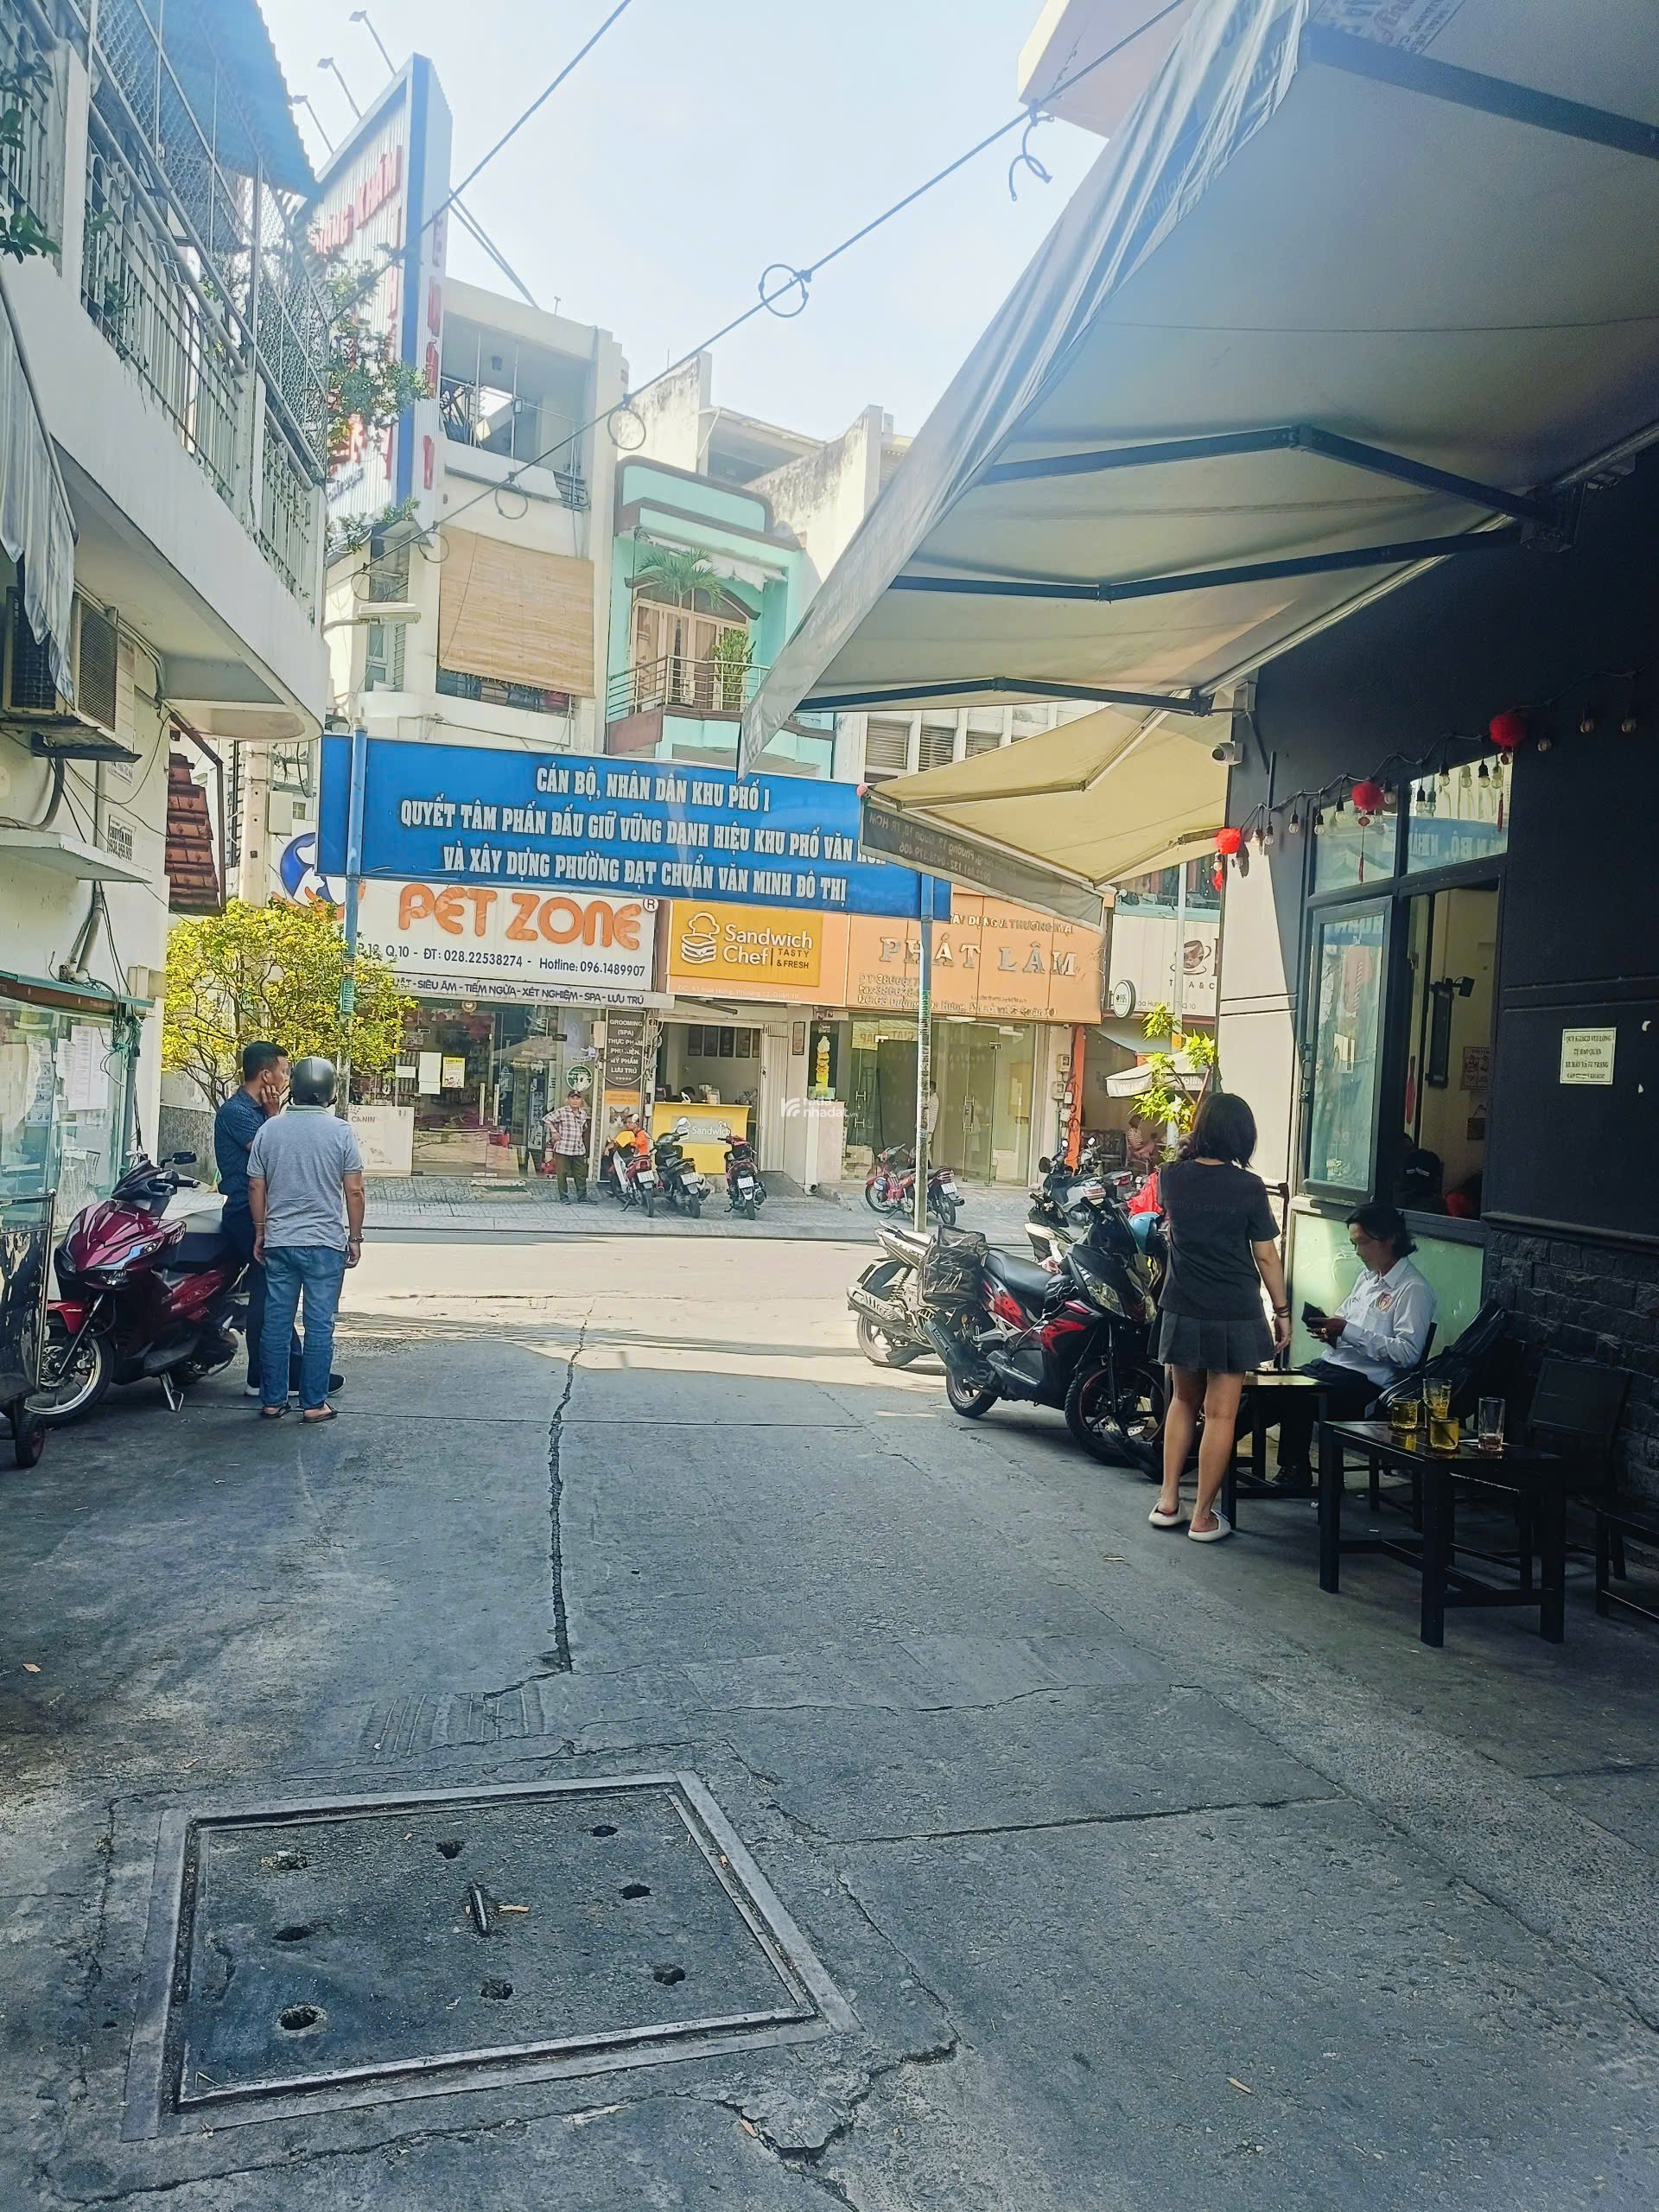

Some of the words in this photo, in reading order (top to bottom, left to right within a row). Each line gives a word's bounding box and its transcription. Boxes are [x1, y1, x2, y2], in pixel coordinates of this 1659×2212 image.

[537, 762, 569, 793] CÁN
[575, 766, 601, 801] BỘ,
[607, 769, 651, 800] NHÂN
[656, 773, 687, 804] DÂN
[692, 781, 724, 807] KHU
[728, 779, 760, 811] PHỐ
[401, 793, 455, 829] QUYẾT
[461, 799, 497, 830] TÂM
[502, 799, 546, 835] PHẤN
[550, 803, 583, 838] ĐẤU
[588, 810, 617, 841] GIỮ
[620, 811, 662, 844] VỮNG
[667, 824, 709, 848] DANH
[713, 821, 750, 856] HIỆU
[754, 830, 785, 855] KHU
[789, 826, 820, 859] PHỐ
[824, 832, 854, 861] VĂN
[443, 839, 465, 872] VÀ
[469, 842, 502, 874] XÂY
[506, 846, 550, 882] DỰNG
[555, 849, 620, 884] PHƯỜNG
[625, 860, 657, 892] ĐẠT
[661, 854, 713, 890] CHUẨN
[718, 864, 748, 893] VĂN
[753, 872, 791, 897] MINH
[796, 869, 817, 899] ĐÔ
[821, 877, 847, 908] THỊ
[398, 883, 498, 938] PET
[724, 924, 813, 950] Sandwich
[423, 948, 442, 960] ĐT:
[444, 949, 523, 967] 028.22538274
[539, 957, 579, 973] Hotline:
[581, 960, 645, 977] 096.1489907
[723, 944, 769, 966] Chef
[778, 948, 810, 958] TASTY
[784, 960, 810, 969] FRESH
[998, 940, 1078, 976] LÂM
[417, 978, 438, 990] SIÊU
[441, 979, 457, 991] ÂM
[522, 987, 540, 997] XÉT
[584, 993, 601, 1002] SPA
[627, 995, 645, 1005] TRÚ
[609, 1019, 643, 1027] GROOMING
